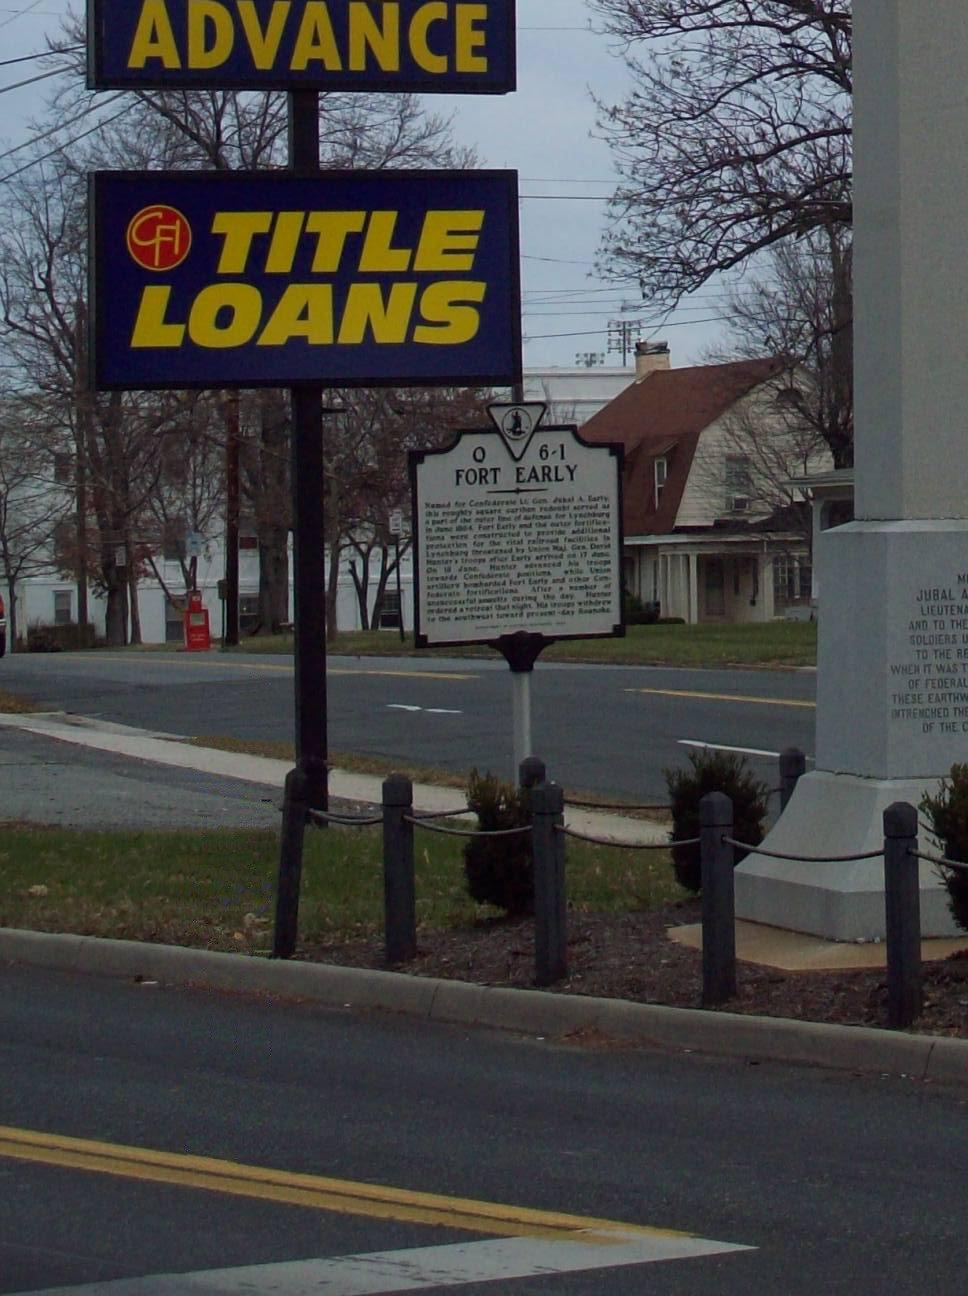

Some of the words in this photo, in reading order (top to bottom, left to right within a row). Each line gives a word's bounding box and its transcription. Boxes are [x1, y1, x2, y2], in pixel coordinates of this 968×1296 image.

[127, 0, 488, 74] ADVANCE
[211, 210, 486, 274] TITLE
[130, 281, 488, 349] LOANS
[472, 446, 487, 463] Q
[538, 444, 567, 461] 6-1
[455, 467, 501, 486] FORT
[515, 464, 579, 484] EARLY
[916, 588, 955, 602] JUBAL
[908, 620, 928, 630] AND
[933, 619, 945, 630] TO
[950, 619, 968, 630] THE
[909, 634, 958, 645] SOLDIERS
[915, 649, 928, 660] TO
[934, 648, 952, 660] THE
[890, 664, 920, 675] WHEN
[923, 664, 932, 674] IT
[936, 663, 958, 674] WAS
[908, 678, 920, 690] OF
[926, 678, 968, 688] FEDERAL
[891, 694, 923, 704] THESE
[891, 707, 950, 720] INTRENCHED
[922, 722, 935, 733] OF
[940, 722, 959, 732] THE
